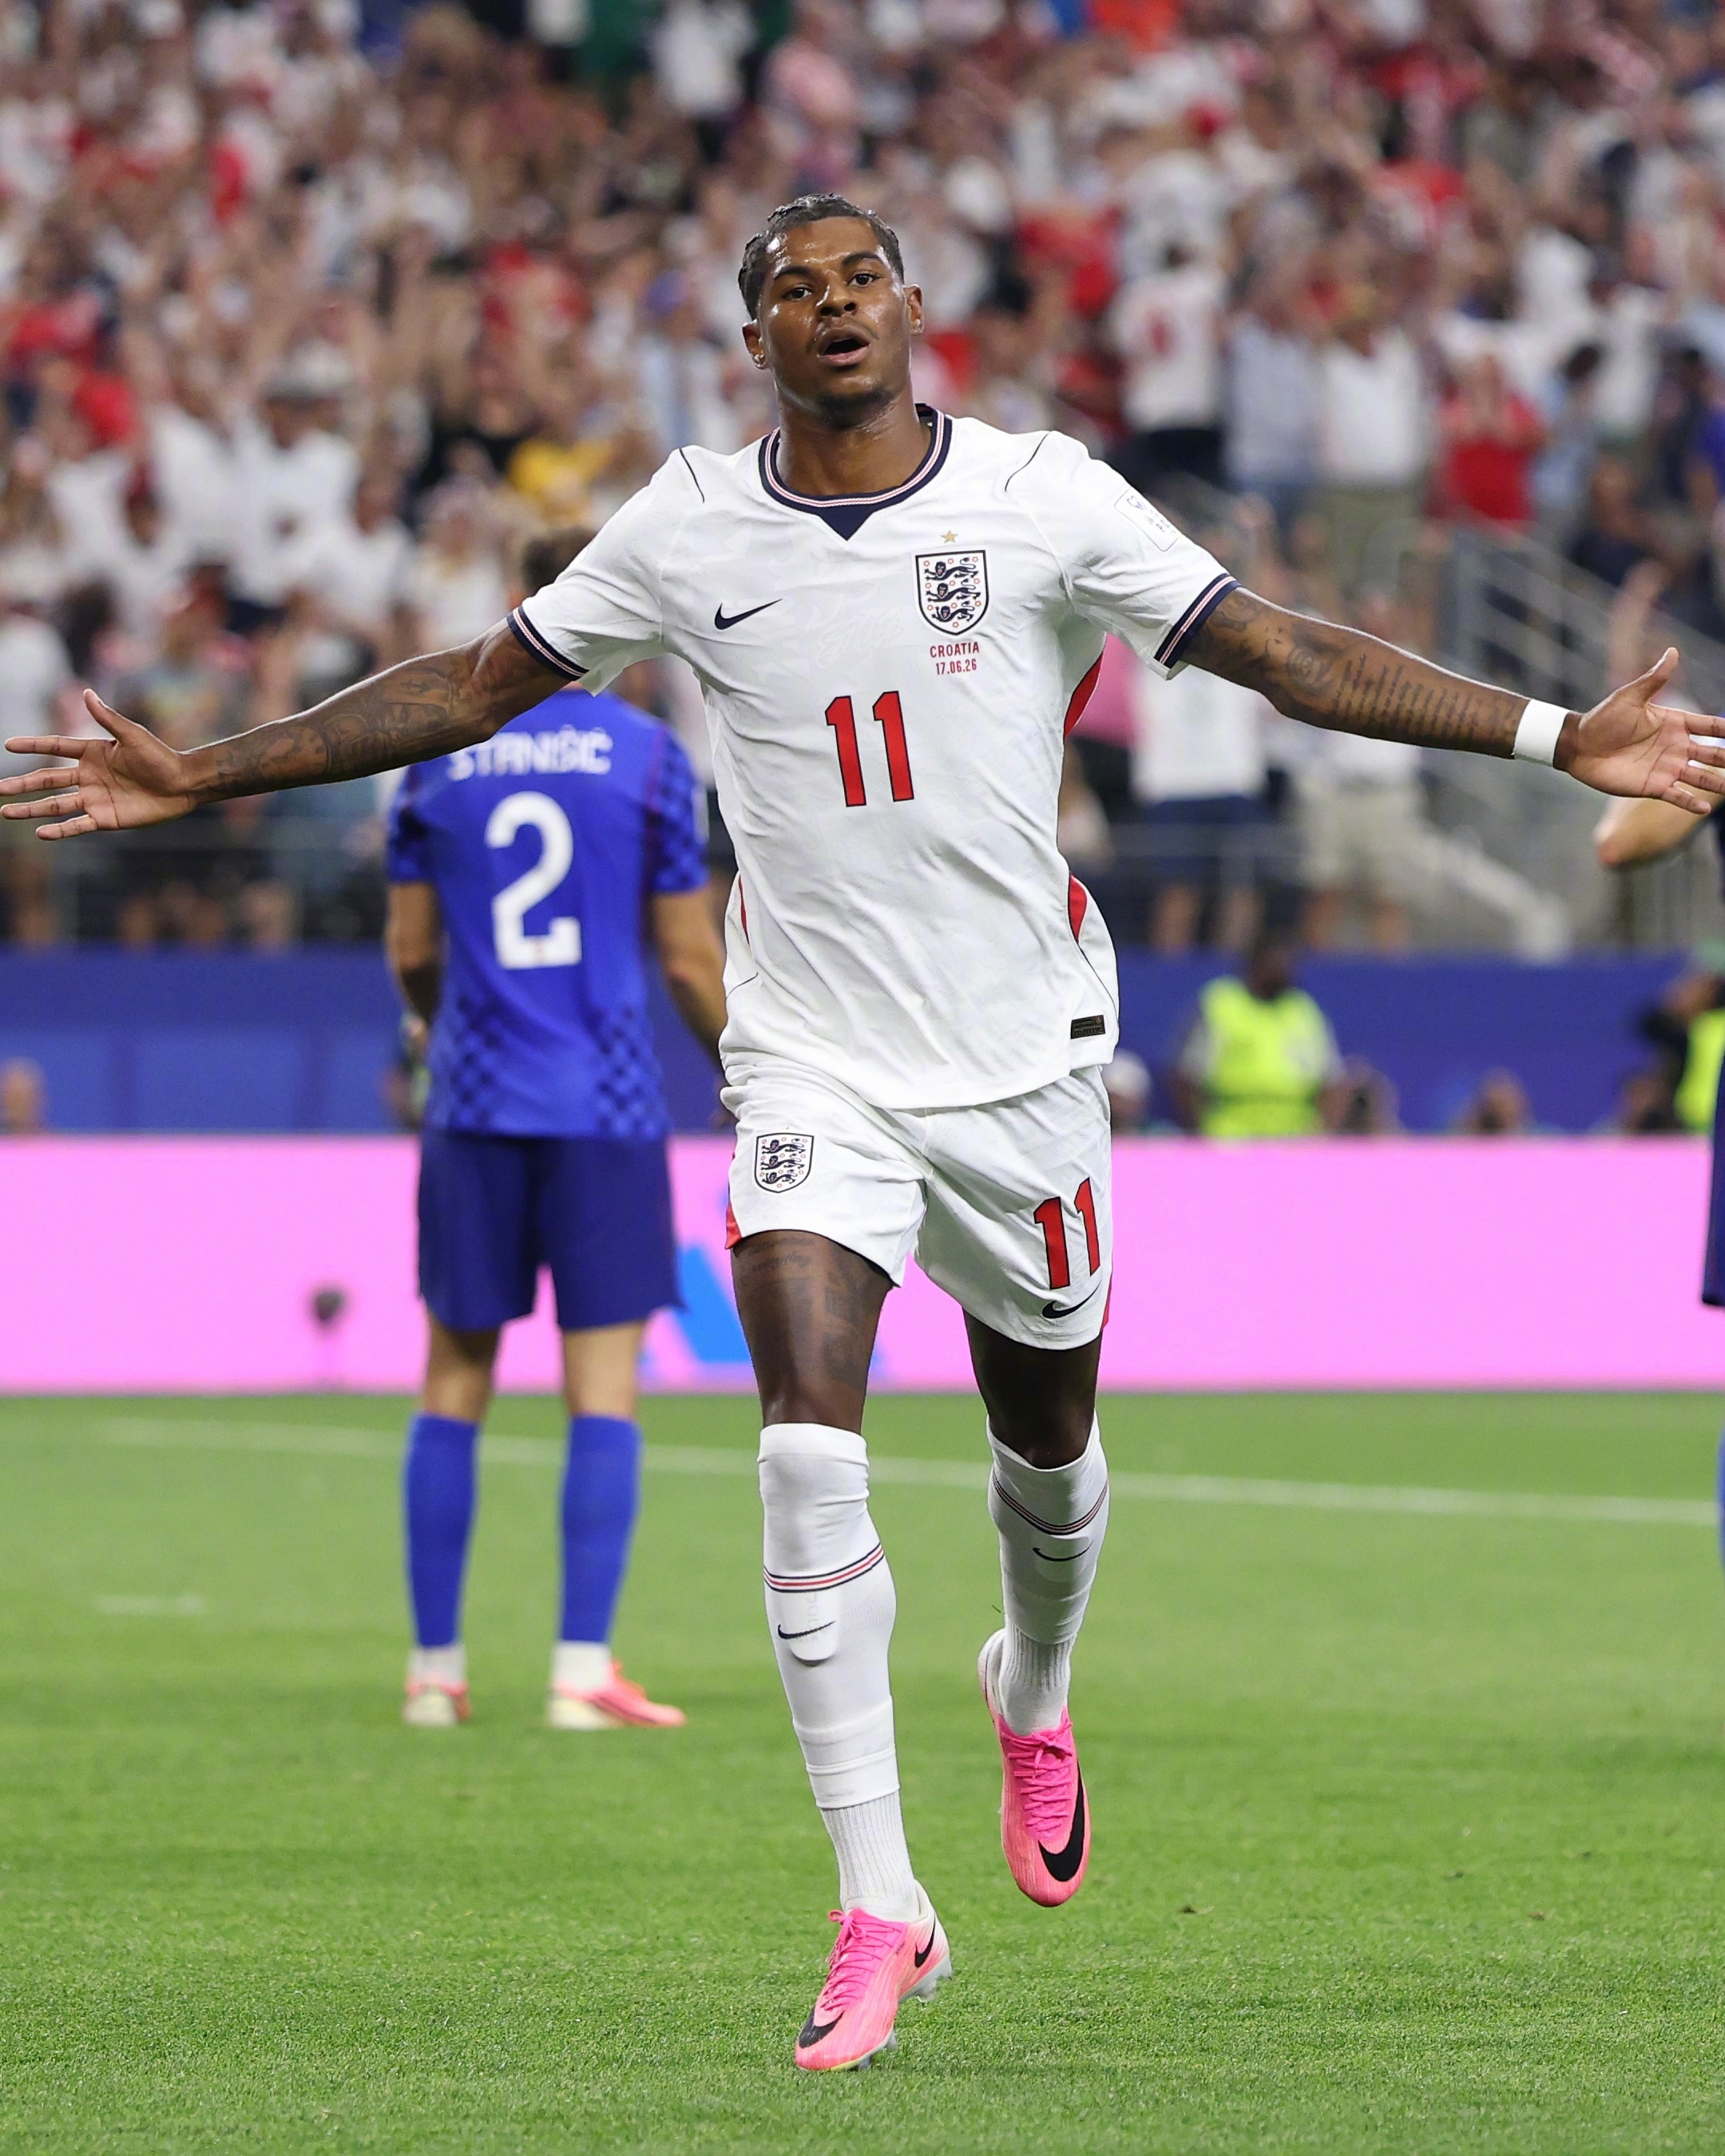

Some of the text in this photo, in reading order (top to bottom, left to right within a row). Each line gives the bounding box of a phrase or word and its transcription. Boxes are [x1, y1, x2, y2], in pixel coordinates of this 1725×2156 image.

[930, 641, 980, 658] CROATIA
[935, 658, 977, 676] 17.06.26
[824, 690, 915, 807] 11
[484, 791, 582, 969] 2
[1033, 1176, 1101, 1290] 11
